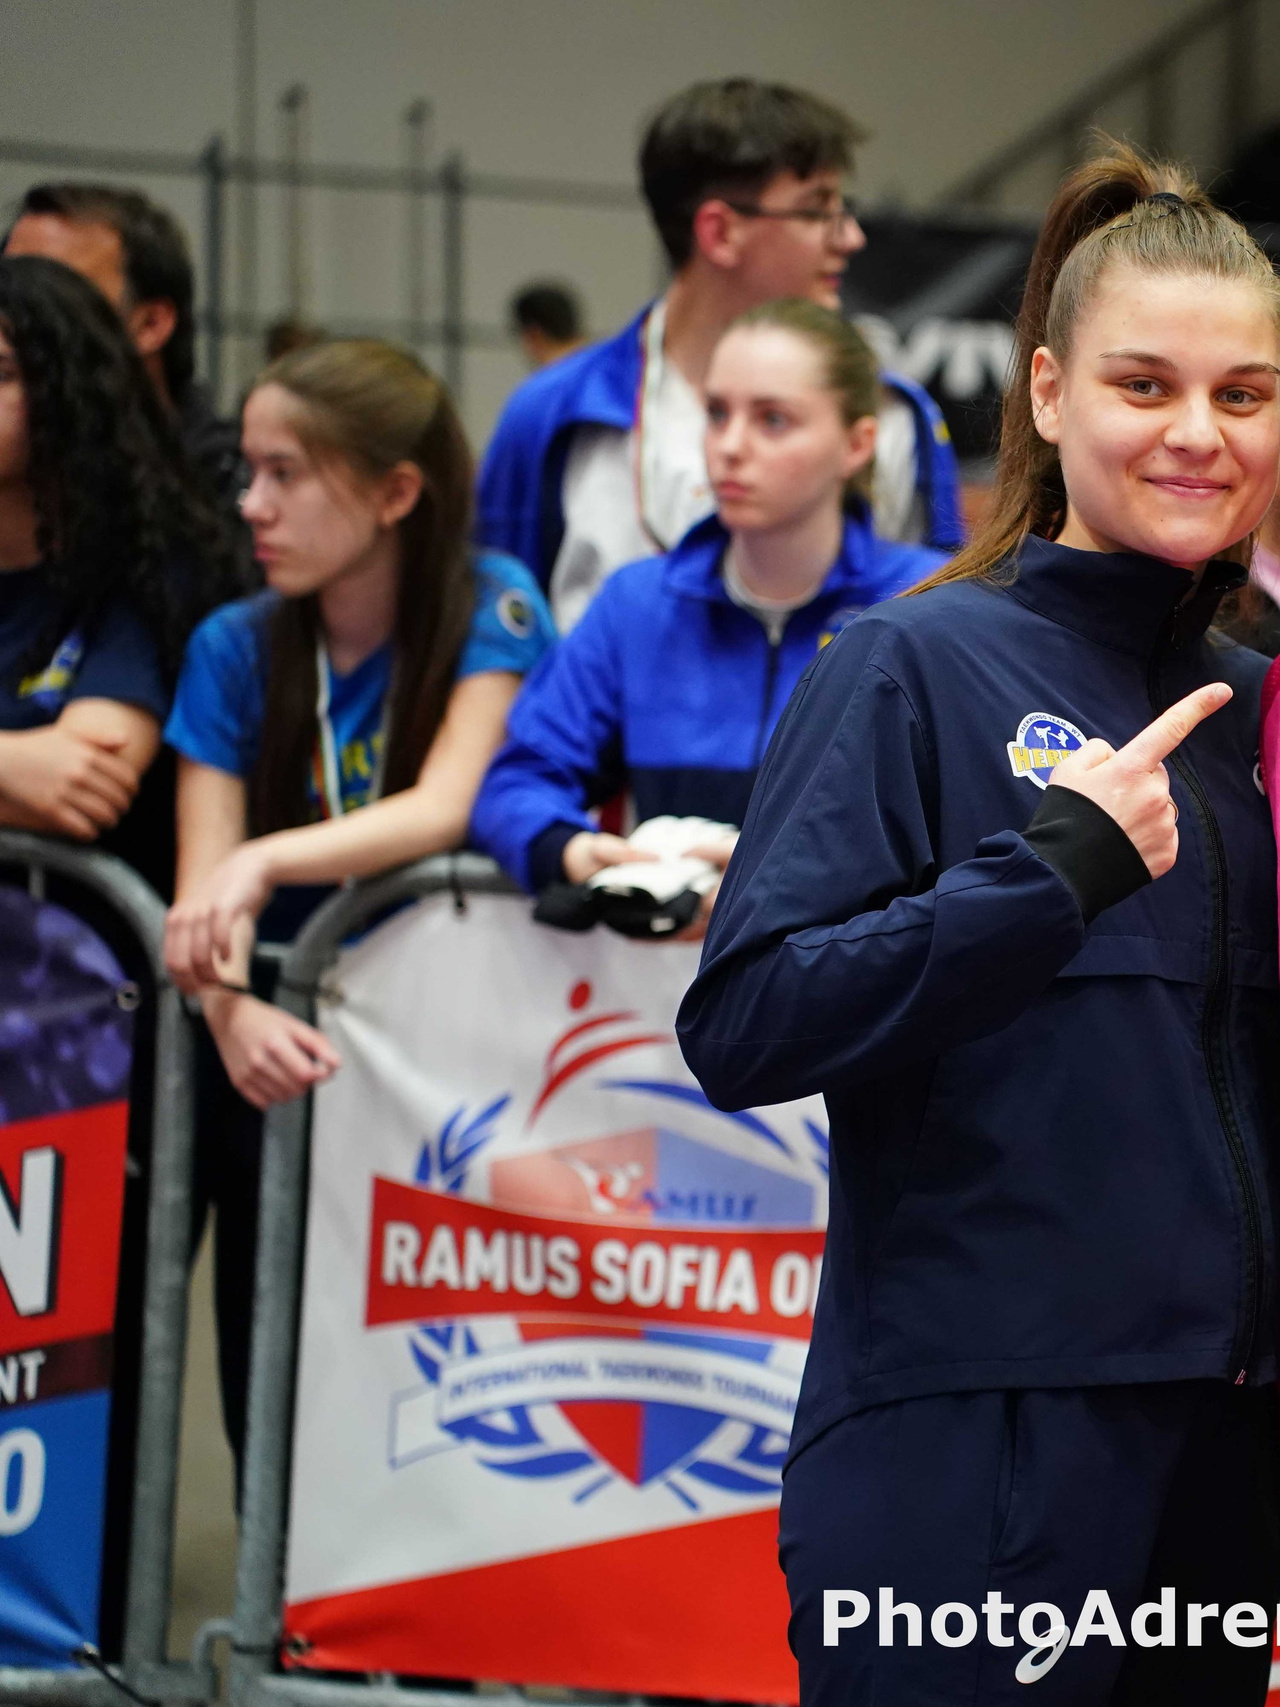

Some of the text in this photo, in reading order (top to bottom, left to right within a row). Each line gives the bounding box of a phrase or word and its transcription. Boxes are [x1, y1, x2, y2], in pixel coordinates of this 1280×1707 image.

[1049, 716, 1067, 728] TEAM
[381, 1222, 824, 1319] RAMUS SOFIA O
